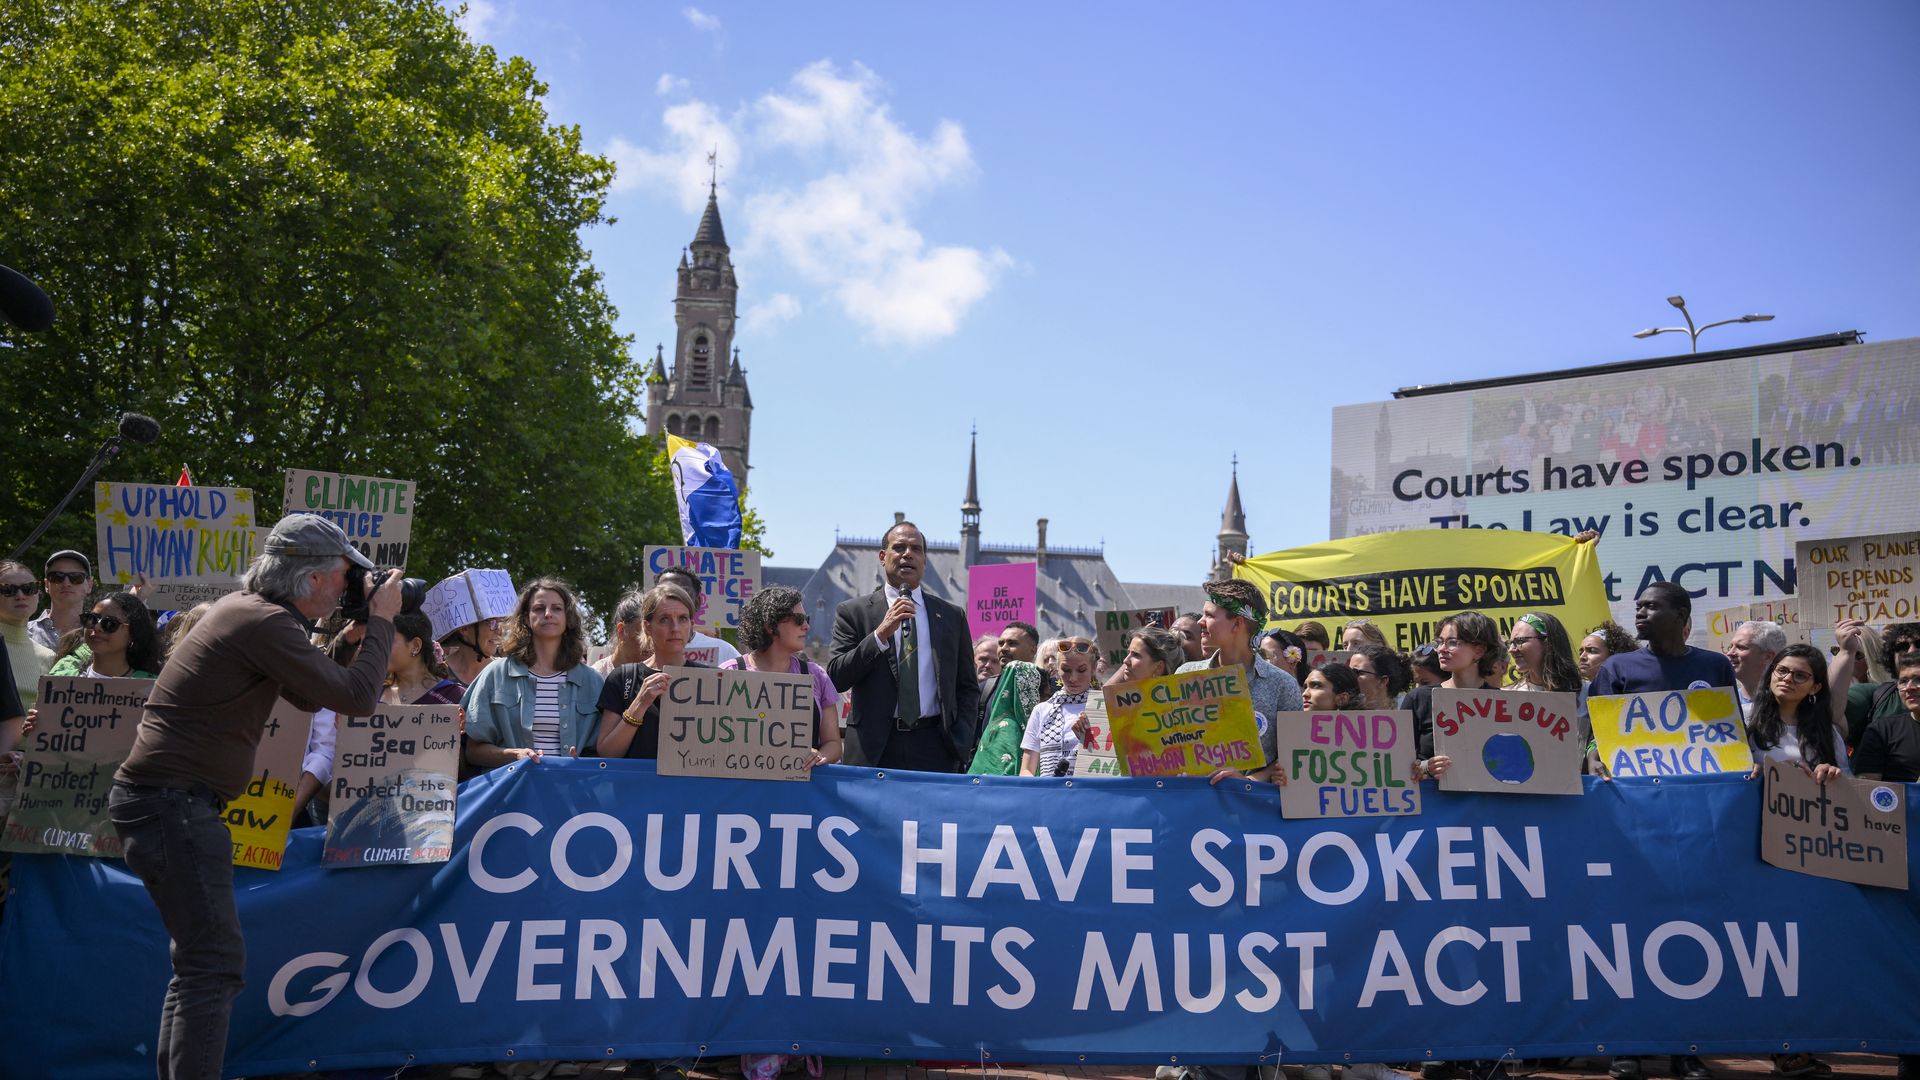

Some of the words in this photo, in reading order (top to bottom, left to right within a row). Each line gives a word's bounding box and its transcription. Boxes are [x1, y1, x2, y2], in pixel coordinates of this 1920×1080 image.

[1392, 463, 1530, 502] Courts
[1543, 457, 1649, 491] have
[1663, 438, 1861, 490] spoken.
[122, 487, 227, 520] UPHOLD
[1625, 503, 1659, 537] is
[1677, 497, 1810, 535] clear.
[107, 525, 193, 577] HUMAN
[1809, 541, 1849, 565] OUR
[1634, 561, 1742, 599] ACT
[1827, 566, 1913, 590] DEPENDS
[175, 593, 208, 602] COURT
[977, 597, 1024, 611] KLIMAAT
[993, 587, 1009, 598] DE
[1274, 580, 1370, 615] COURTS
[1380, 575, 1446, 609] HAVE
[1457, 571, 1559, 604] SPOKEN
[1871, 589, 1890, 598] THE
[981, 611, 992, 622] IS
[994, 610, 1019, 622] VOL!
[1106, 611, 1130, 631] AO
[1116, 692, 1141, 707] NO
[1151, 675, 1242, 704] CLIMATE
[60, 707, 122, 729] Court
[411, 712, 424, 725] of
[431, 713, 451, 724] the
[1142, 704, 1219, 733] JUSTICE
[1436, 698, 1512, 737] SAVE
[1518, 702, 1571, 741] OUR
[1624, 692, 1688, 733] AO
[35, 728, 87, 752] said
[370, 732, 416, 755] Sea
[423, 734, 457, 750] Court
[1310, 714, 1397, 749] END
[1688, 722, 1738, 744] FOR
[341, 752, 387, 768] said
[677, 750, 716, 769] Yumi
[725, 753, 750, 769] GO
[754, 754, 775, 770] GO
[1127, 749, 1186, 776] HUMAN
[1612, 746, 1722, 776] AFRICA
[24, 761, 99, 790] Protect
[335, 774, 404, 799] Protect
[419, 780, 445, 791] the
[273, 781, 295, 799] the
[1318, 786, 1416, 816] FUELS
[1768, 766, 1849, 831] Courts
[1864, 815, 1901, 834] have
[19, 793, 63, 809] Human
[74, 793, 110, 815] Righ
[401, 793, 454, 812] Ocean
[221, 808, 278, 831] aw
[43, 827, 92, 850] CLIMATE
[1785, 830, 1884, 867] spoken
[243, 844, 282, 867] ACTION
[363, 847, 412, 862] CLIMATE
[469, 812, 860, 894] COURTS
[899, 819, 1154, 905] HAVE
[1189, 825, 1547, 908] SPOKEN
[267, 916, 1036, 1018] GOVERNMENTS
[1072, 930, 1327, 1014] MUST
[1357, 925, 1531, 1007] ACT
[1567, 920, 1799, 1001] NOW
